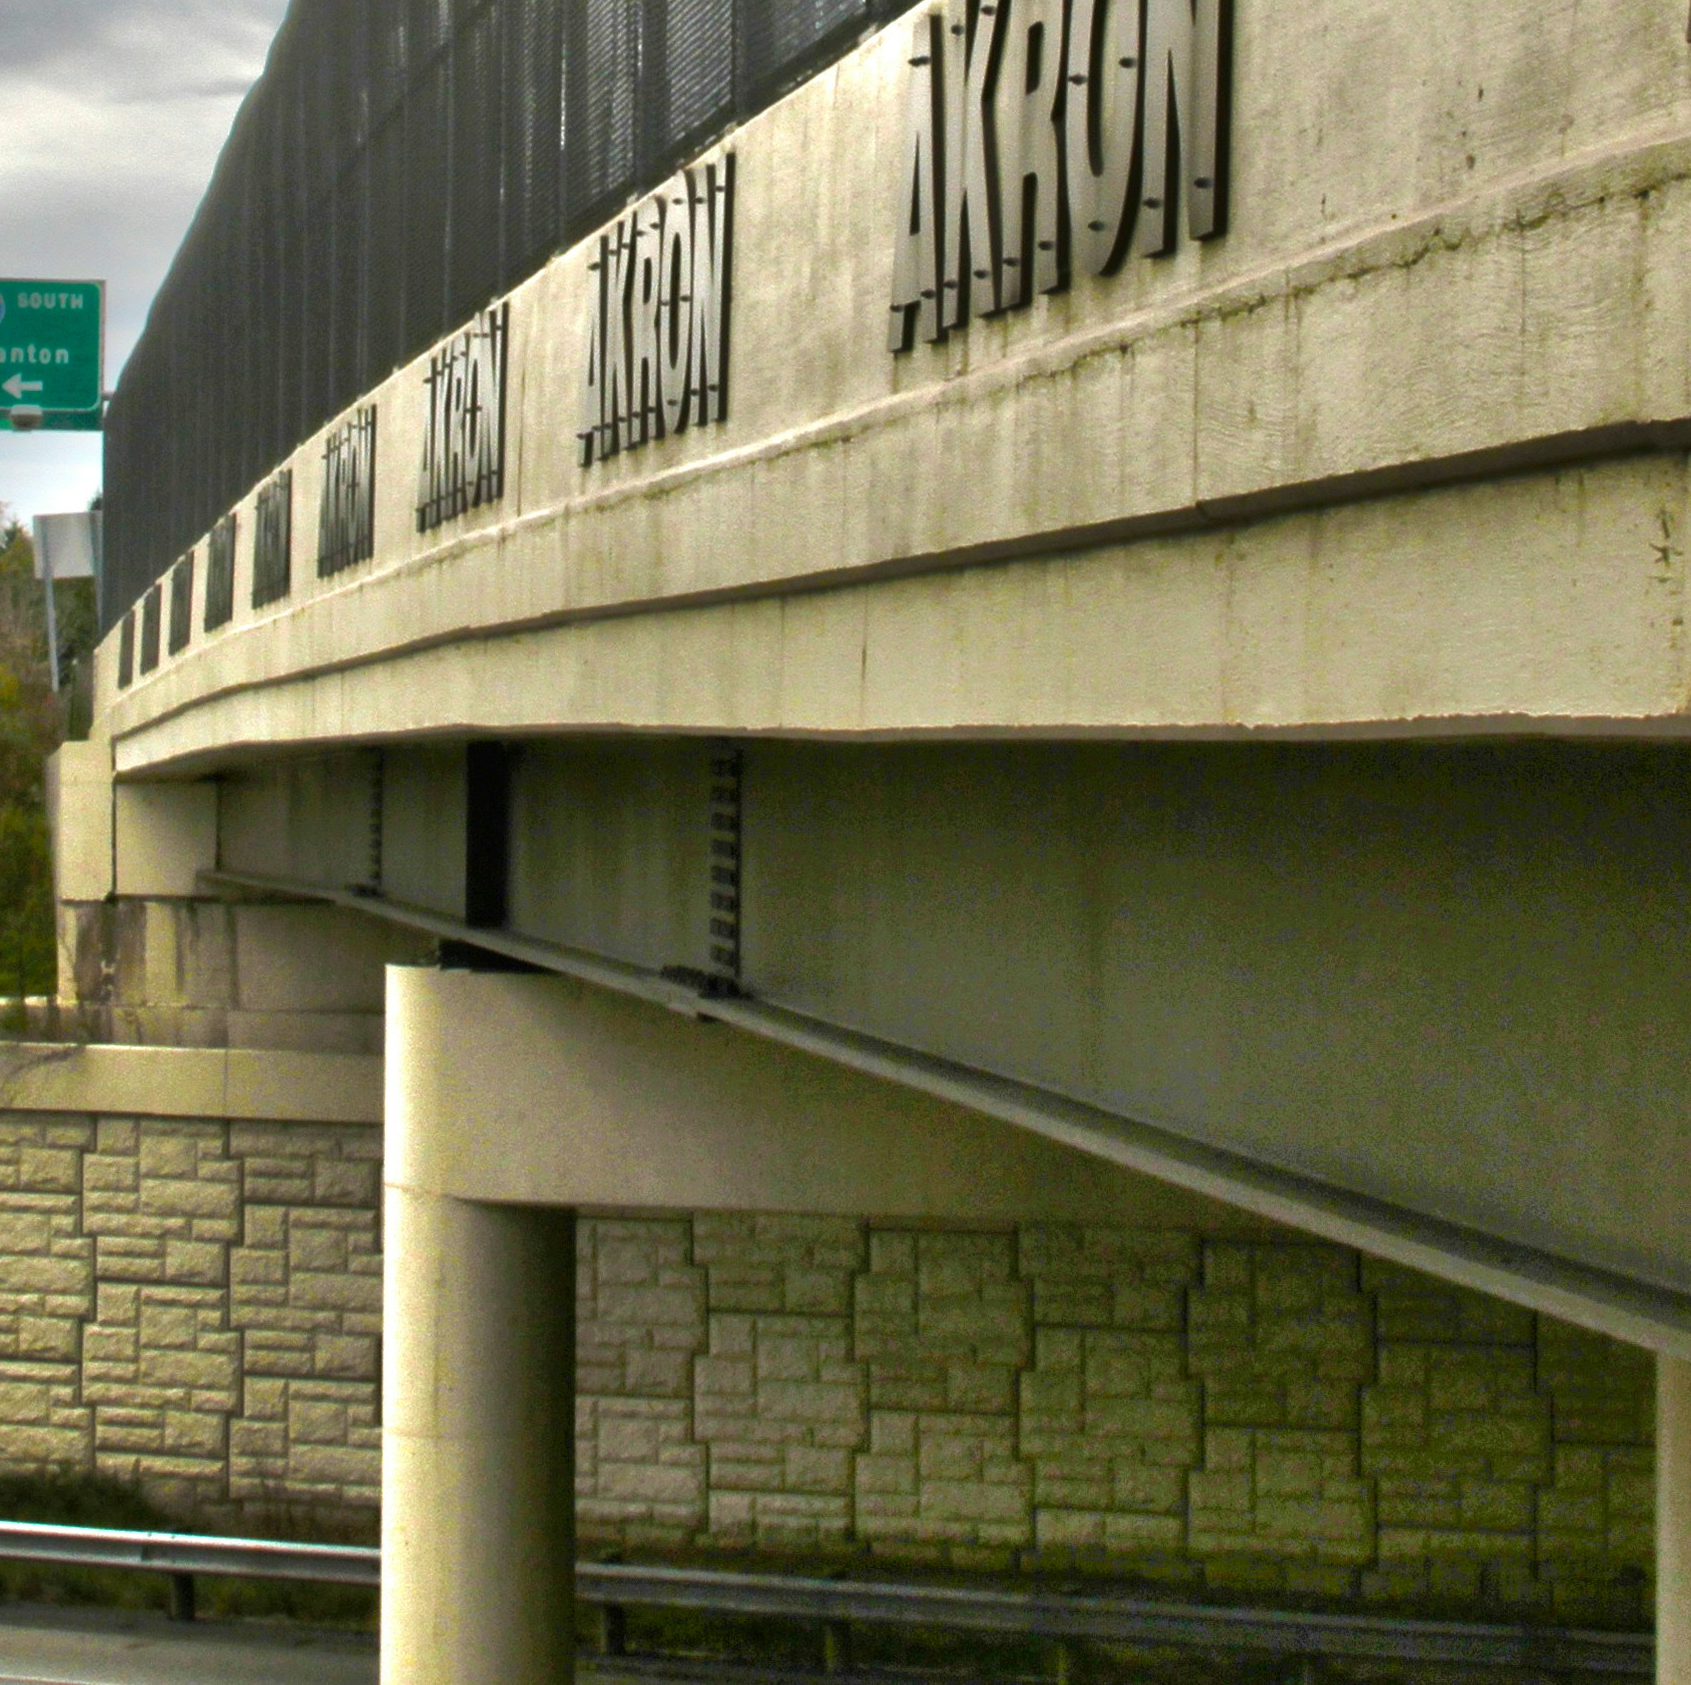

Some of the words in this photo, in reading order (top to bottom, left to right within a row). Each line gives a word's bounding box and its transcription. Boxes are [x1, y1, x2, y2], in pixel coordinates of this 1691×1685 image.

[18, 293, 83, 309] SOUTH
[415, 300, 510, 534] AKRON
[577, 151, 737, 469] AKRON
